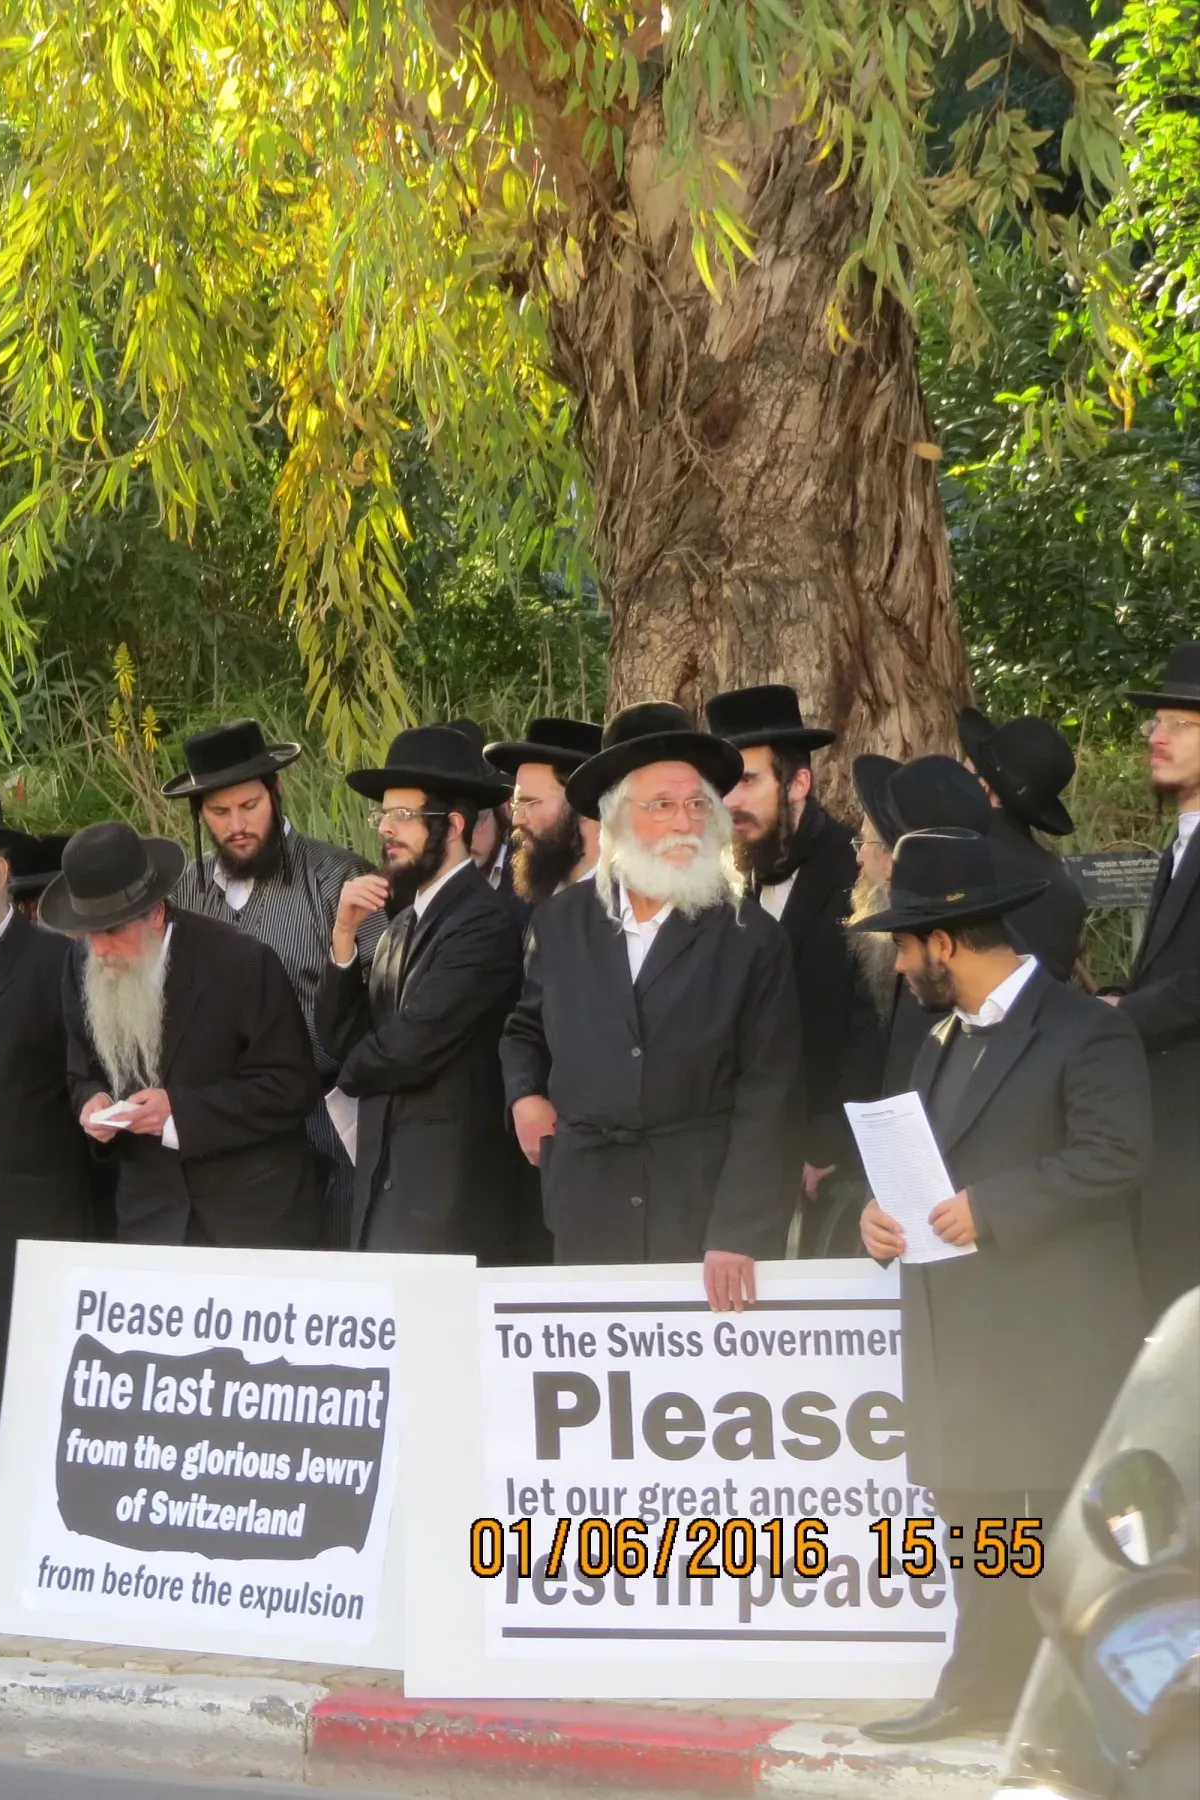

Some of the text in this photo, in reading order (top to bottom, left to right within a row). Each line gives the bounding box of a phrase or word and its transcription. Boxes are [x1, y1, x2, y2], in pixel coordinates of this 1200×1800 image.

[76, 1290, 396, 1351] Please do not erase
[495, 1322, 901, 1359] To the Swiss Governmen
[73, 1359, 384, 1429] the last remnant
[533, 1371, 906, 1460] Please
[66, 1427, 374, 1495] from the glorious Jewry
[115, 1487, 307, 1538] of Switzerland
[507, 1478, 938, 1522] let our great ancestors
[38, 1555, 364, 1620] from before the expulsion
[738, 1554, 946, 1624] peace
